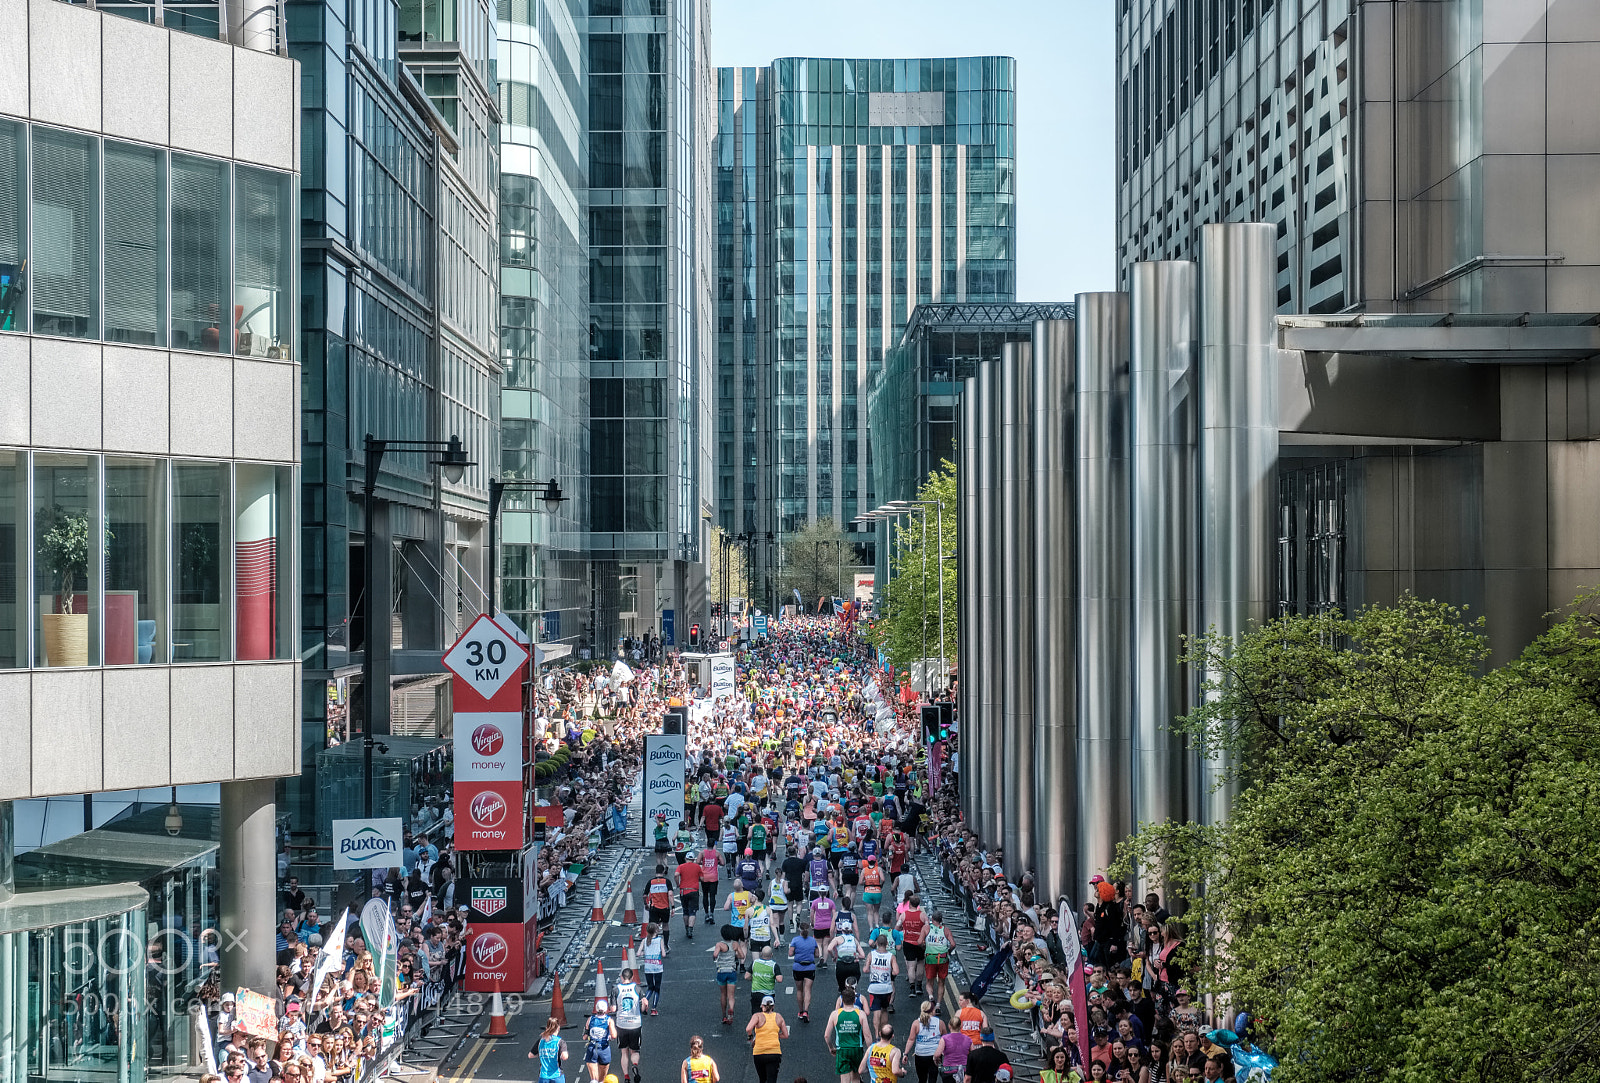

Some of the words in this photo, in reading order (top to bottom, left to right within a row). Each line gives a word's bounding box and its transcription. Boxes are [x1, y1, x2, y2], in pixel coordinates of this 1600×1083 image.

[466, 639, 507, 666] 30
[475, 668, 499, 681] KM
[474, 727, 502, 753] Virgin
[650, 750, 682, 761] Buxton
[471, 761, 506, 771] money
[650, 779, 682, 790] Buxton
[474, 796, 503, 822] Virgin
[649, 808, 681, 819] Buxton
[472, 830, 506, 840] money
[340, 836, 397, 854] Buxton
[474, 888, 504, 898] TAG
[473, 899, 505, 914] HEUER
[476, 937, 504, 963] Virgin
[874, 957, 887, 966] ZAK
[473, 971, 508, 982] money
